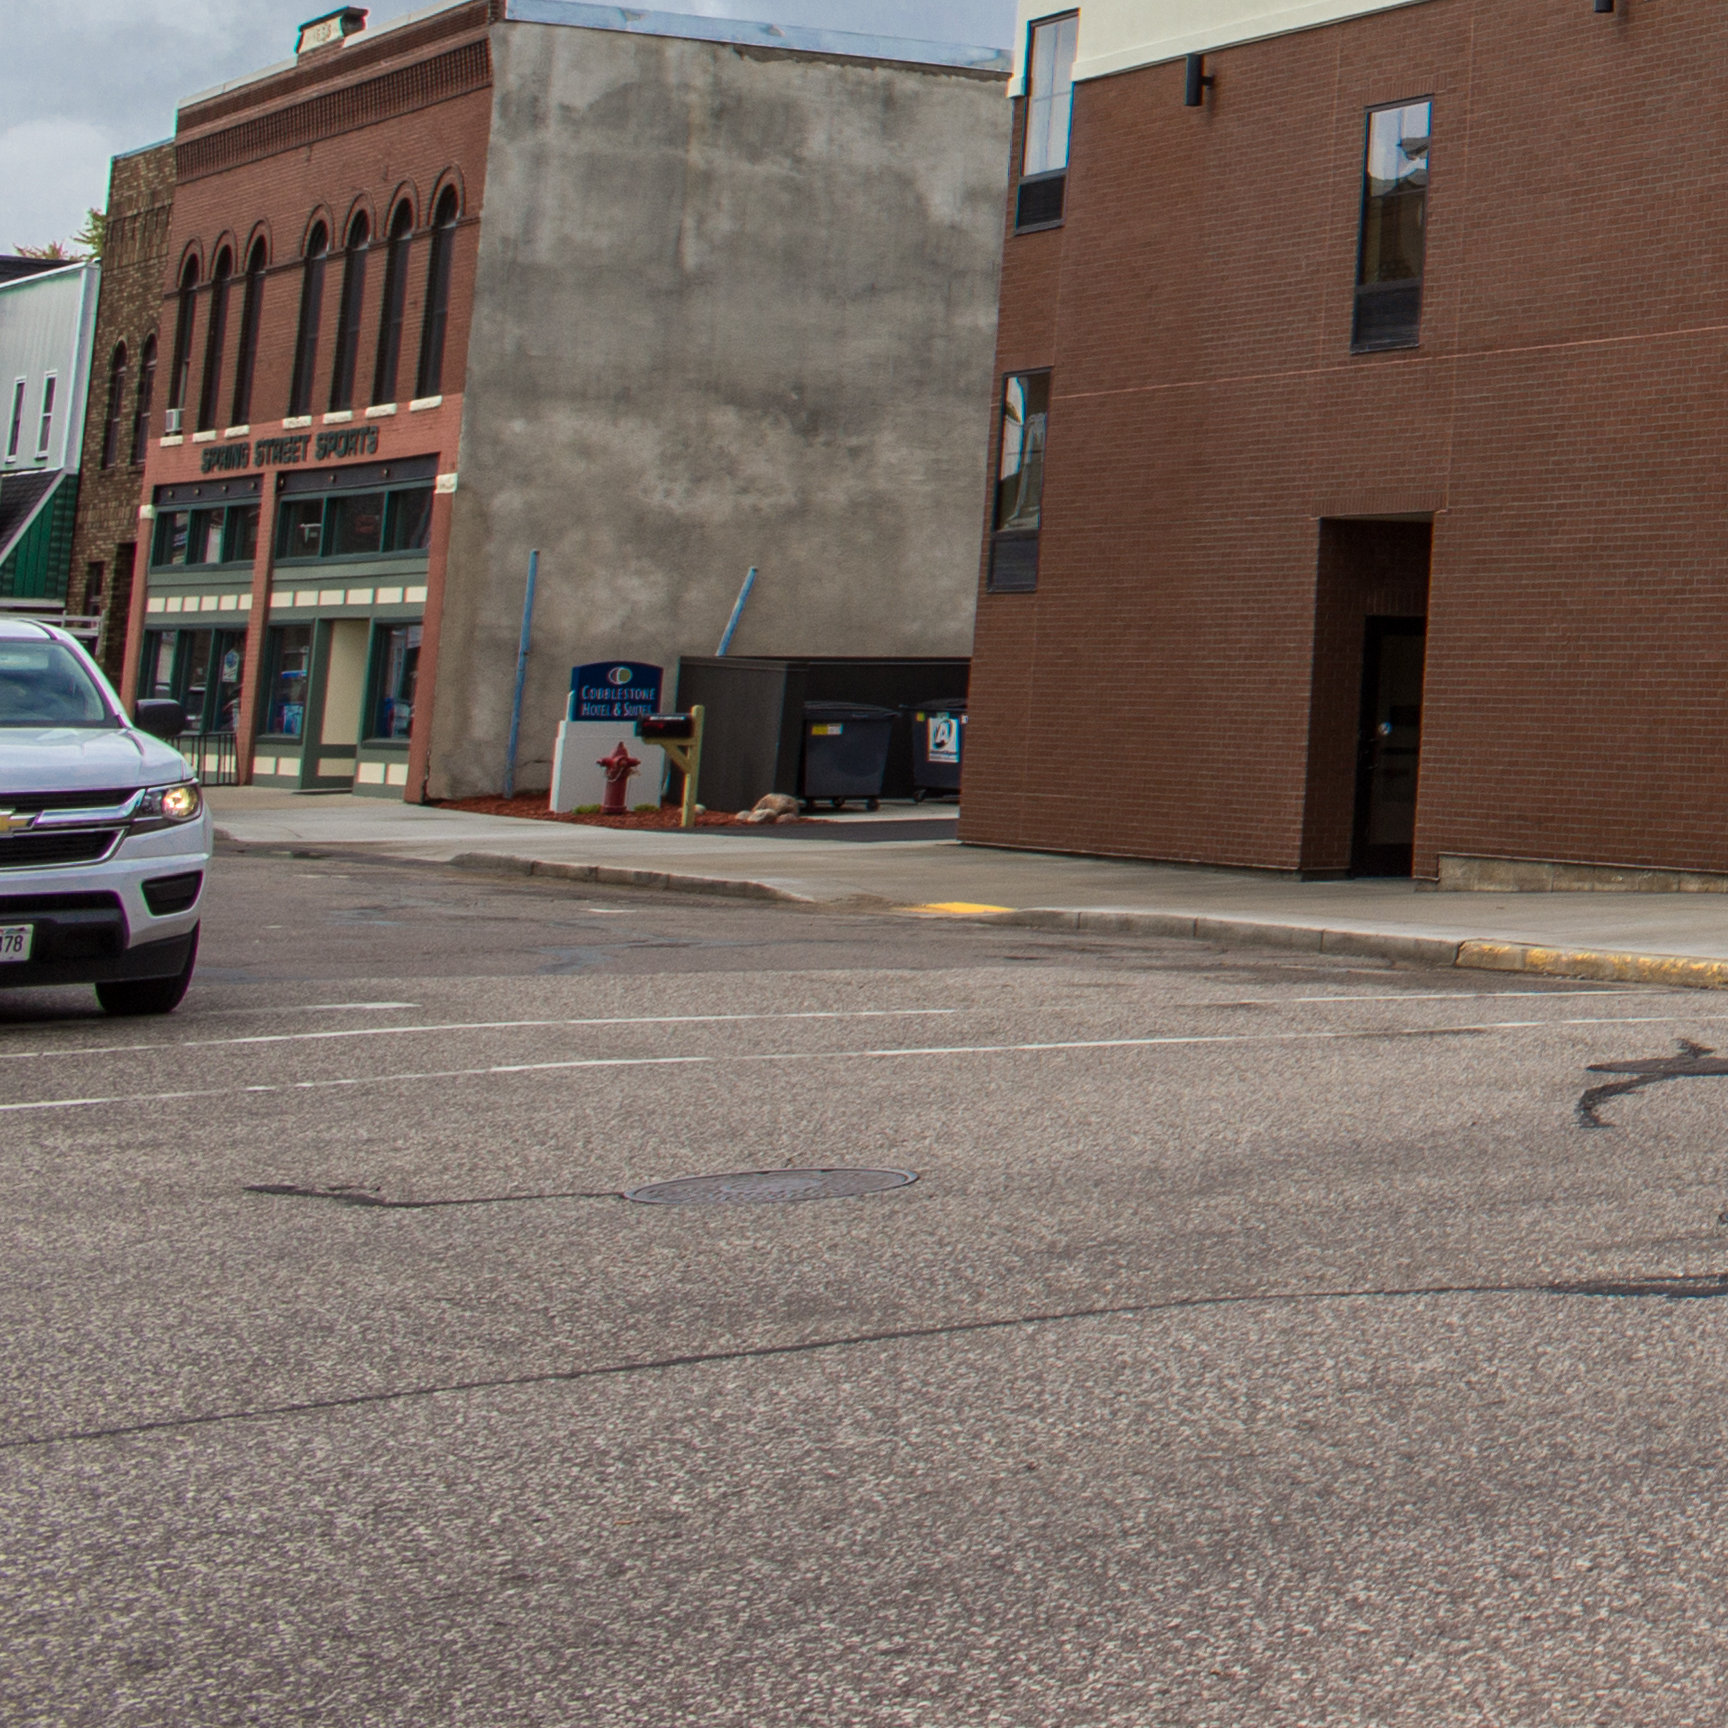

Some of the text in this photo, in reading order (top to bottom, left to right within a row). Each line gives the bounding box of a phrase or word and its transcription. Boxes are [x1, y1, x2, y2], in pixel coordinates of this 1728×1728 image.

[202, 426, 379, 474] SPRING STREET SPORTS
[582, 685, 656, 700] COBBLESTONE
[581, 702, 610, 717] HOTEL
